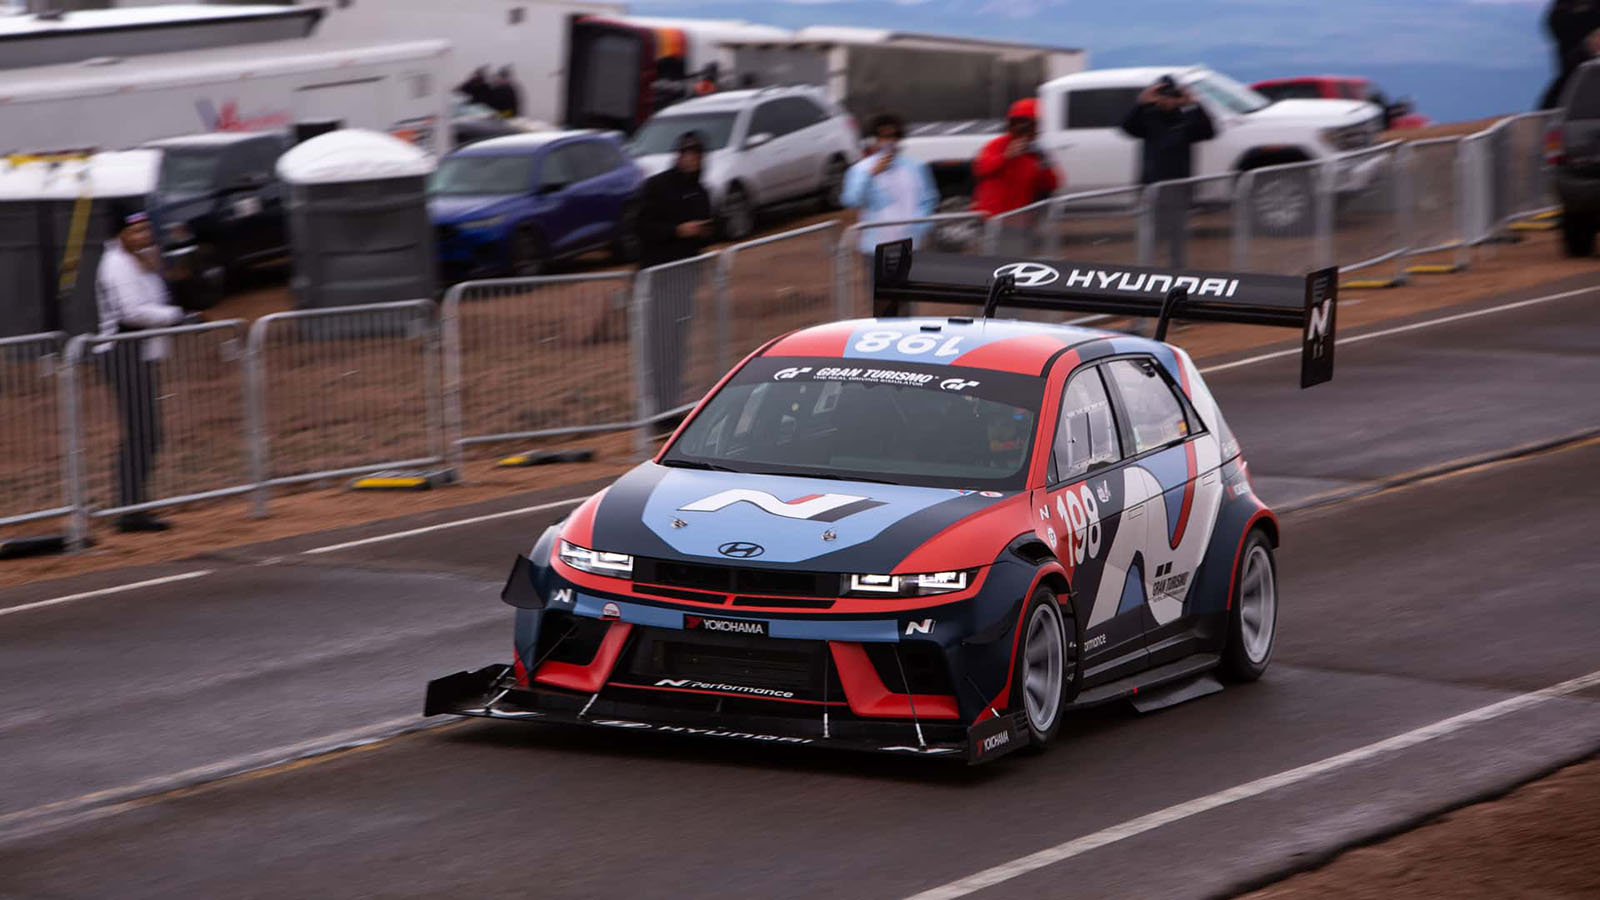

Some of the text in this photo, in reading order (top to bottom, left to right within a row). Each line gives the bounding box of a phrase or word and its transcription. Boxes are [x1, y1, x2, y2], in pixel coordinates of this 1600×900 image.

[1066, 269, 1239, 297] HYUNDAI
[854, 331, 966, 357] 198
[816, 367, 934, 384] GRAN TURISMO
[1057, 485, 1101, 567] 198
[704, 619, 764, 634] YOKOHAMA
[691, 681, 794, 698] Performance
[658, 726, 814, 743] HYUNDAI
